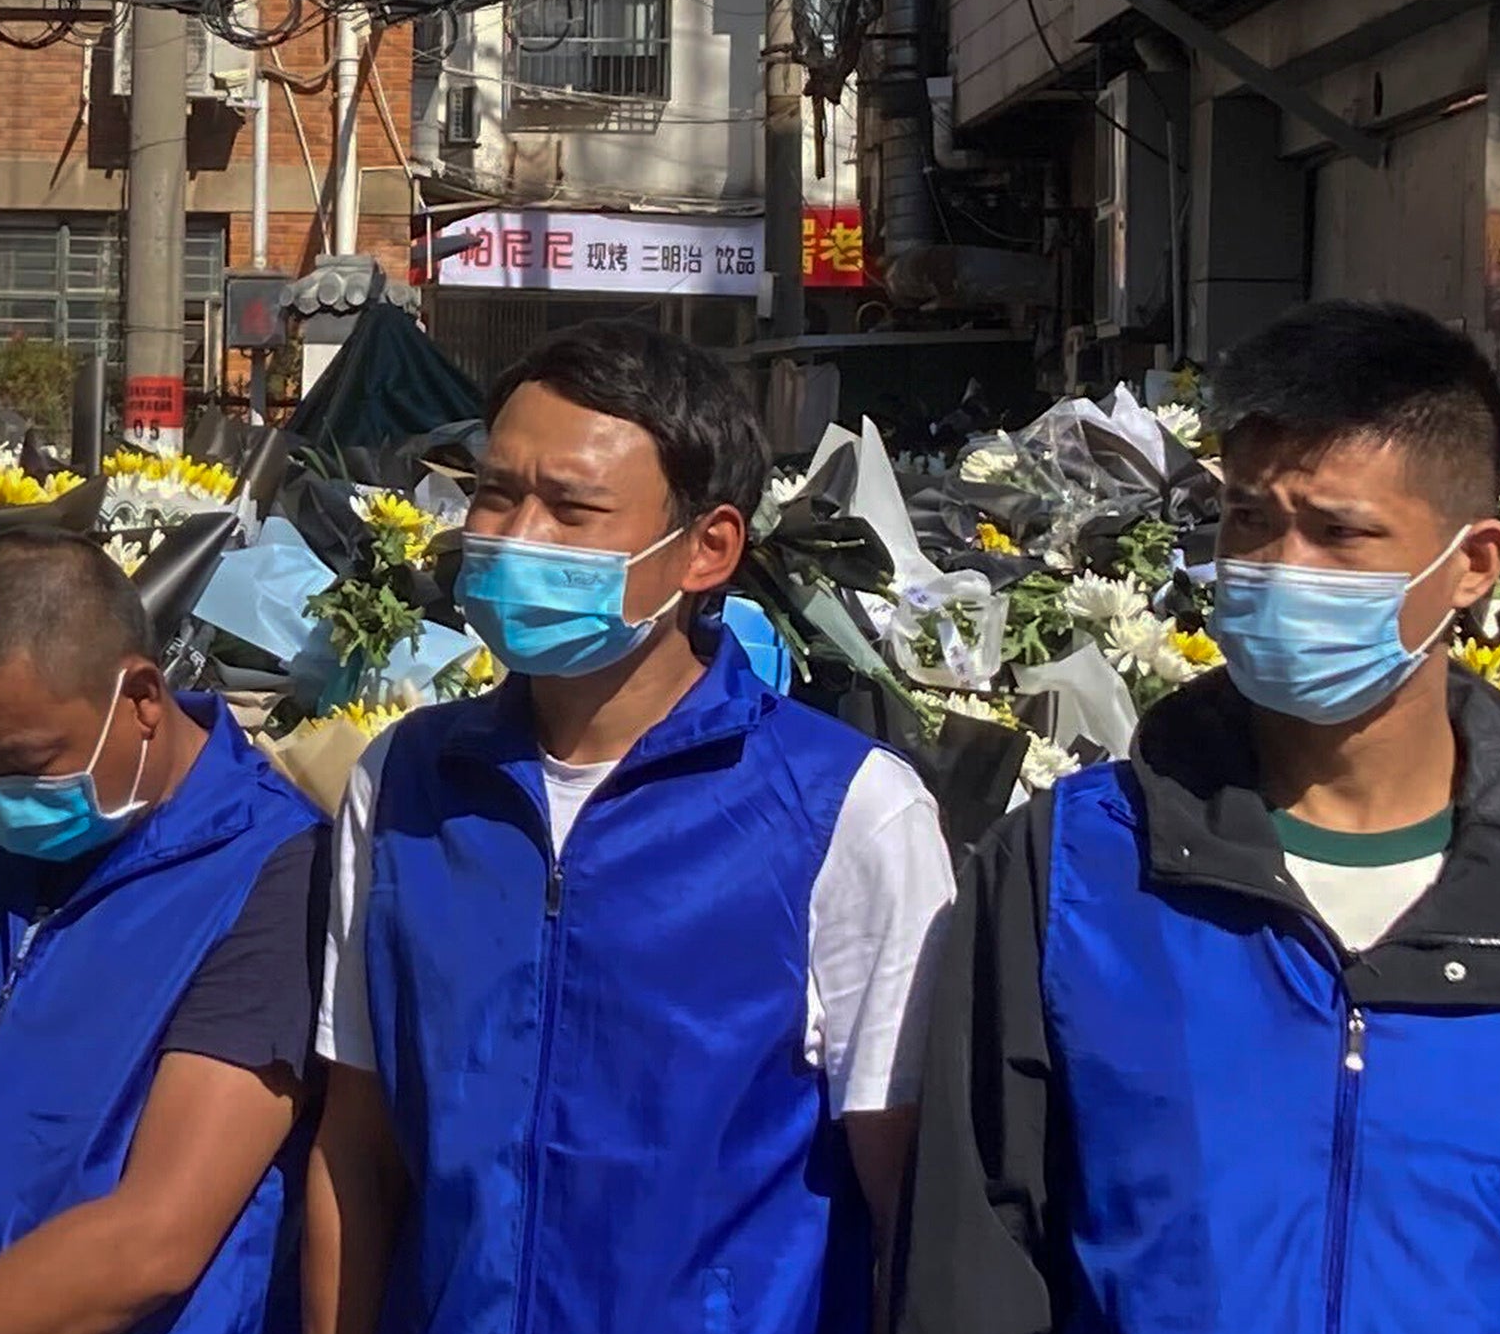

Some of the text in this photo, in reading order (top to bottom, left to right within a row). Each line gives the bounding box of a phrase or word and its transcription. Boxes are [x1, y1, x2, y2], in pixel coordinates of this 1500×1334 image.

[586, 243, 628, 273] 现烤
[641, 244, 703, 275] 三明治
[715, 245, 756, 276] 饮品
